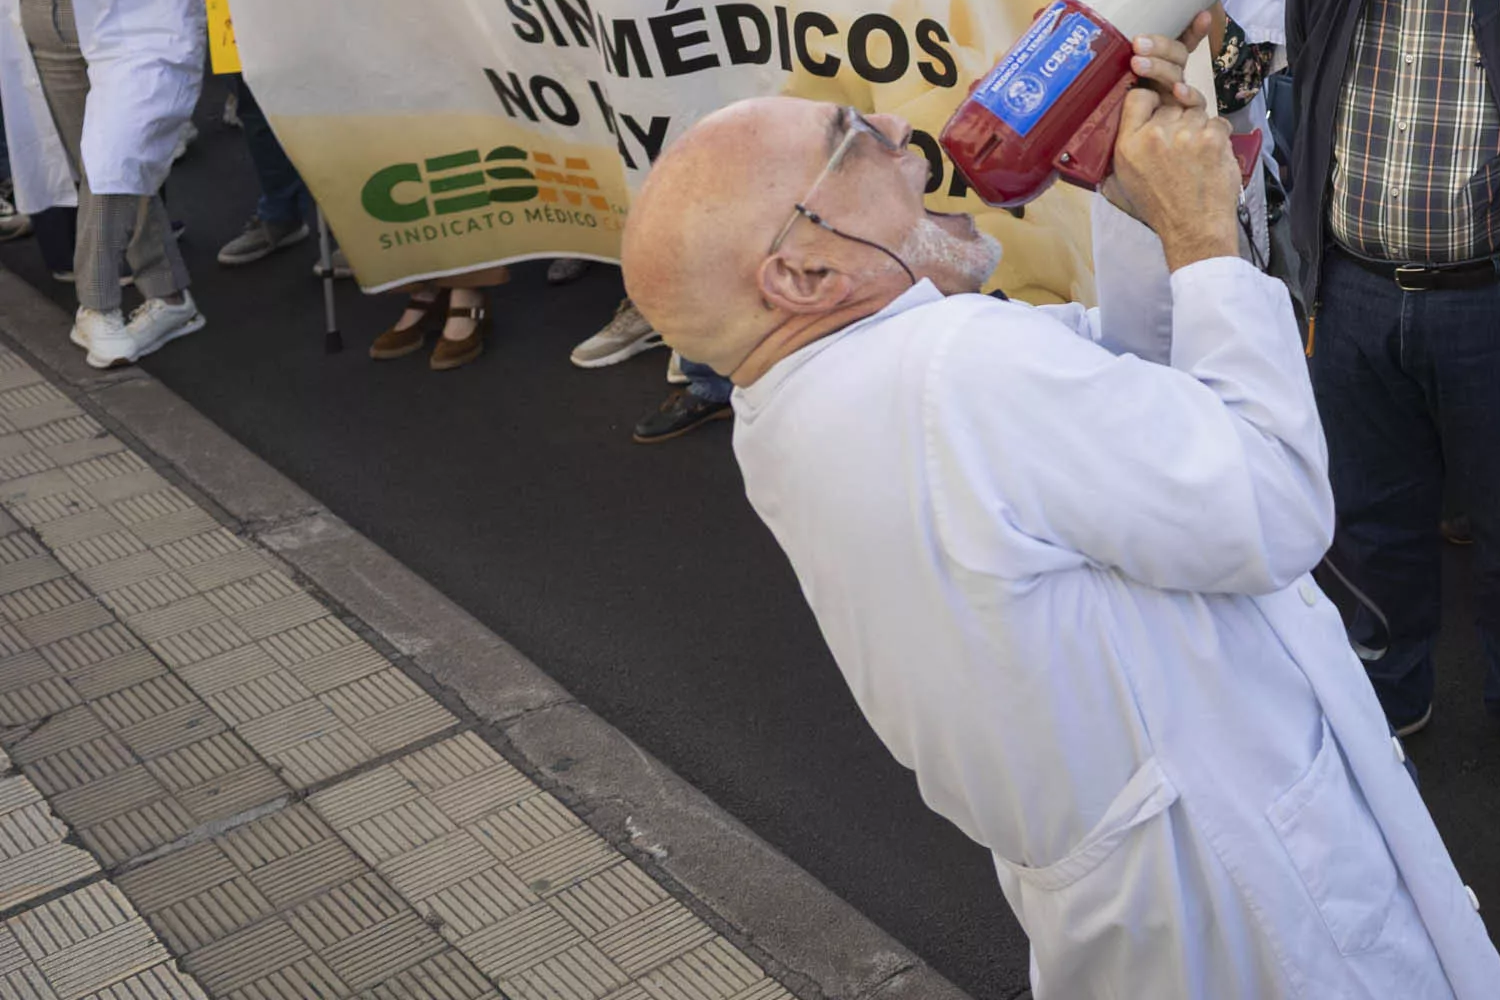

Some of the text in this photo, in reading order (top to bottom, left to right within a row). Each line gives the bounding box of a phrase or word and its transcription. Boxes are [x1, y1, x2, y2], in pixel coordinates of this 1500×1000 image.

[1040, 24, 1090, 78] (CESM)
[483, 66, 581, 127] NO
[360, 145, 609, 224] CESM
[378, 211, 515, 251] SINDICATO
[525, 202, 598, 229] MÉDICO
